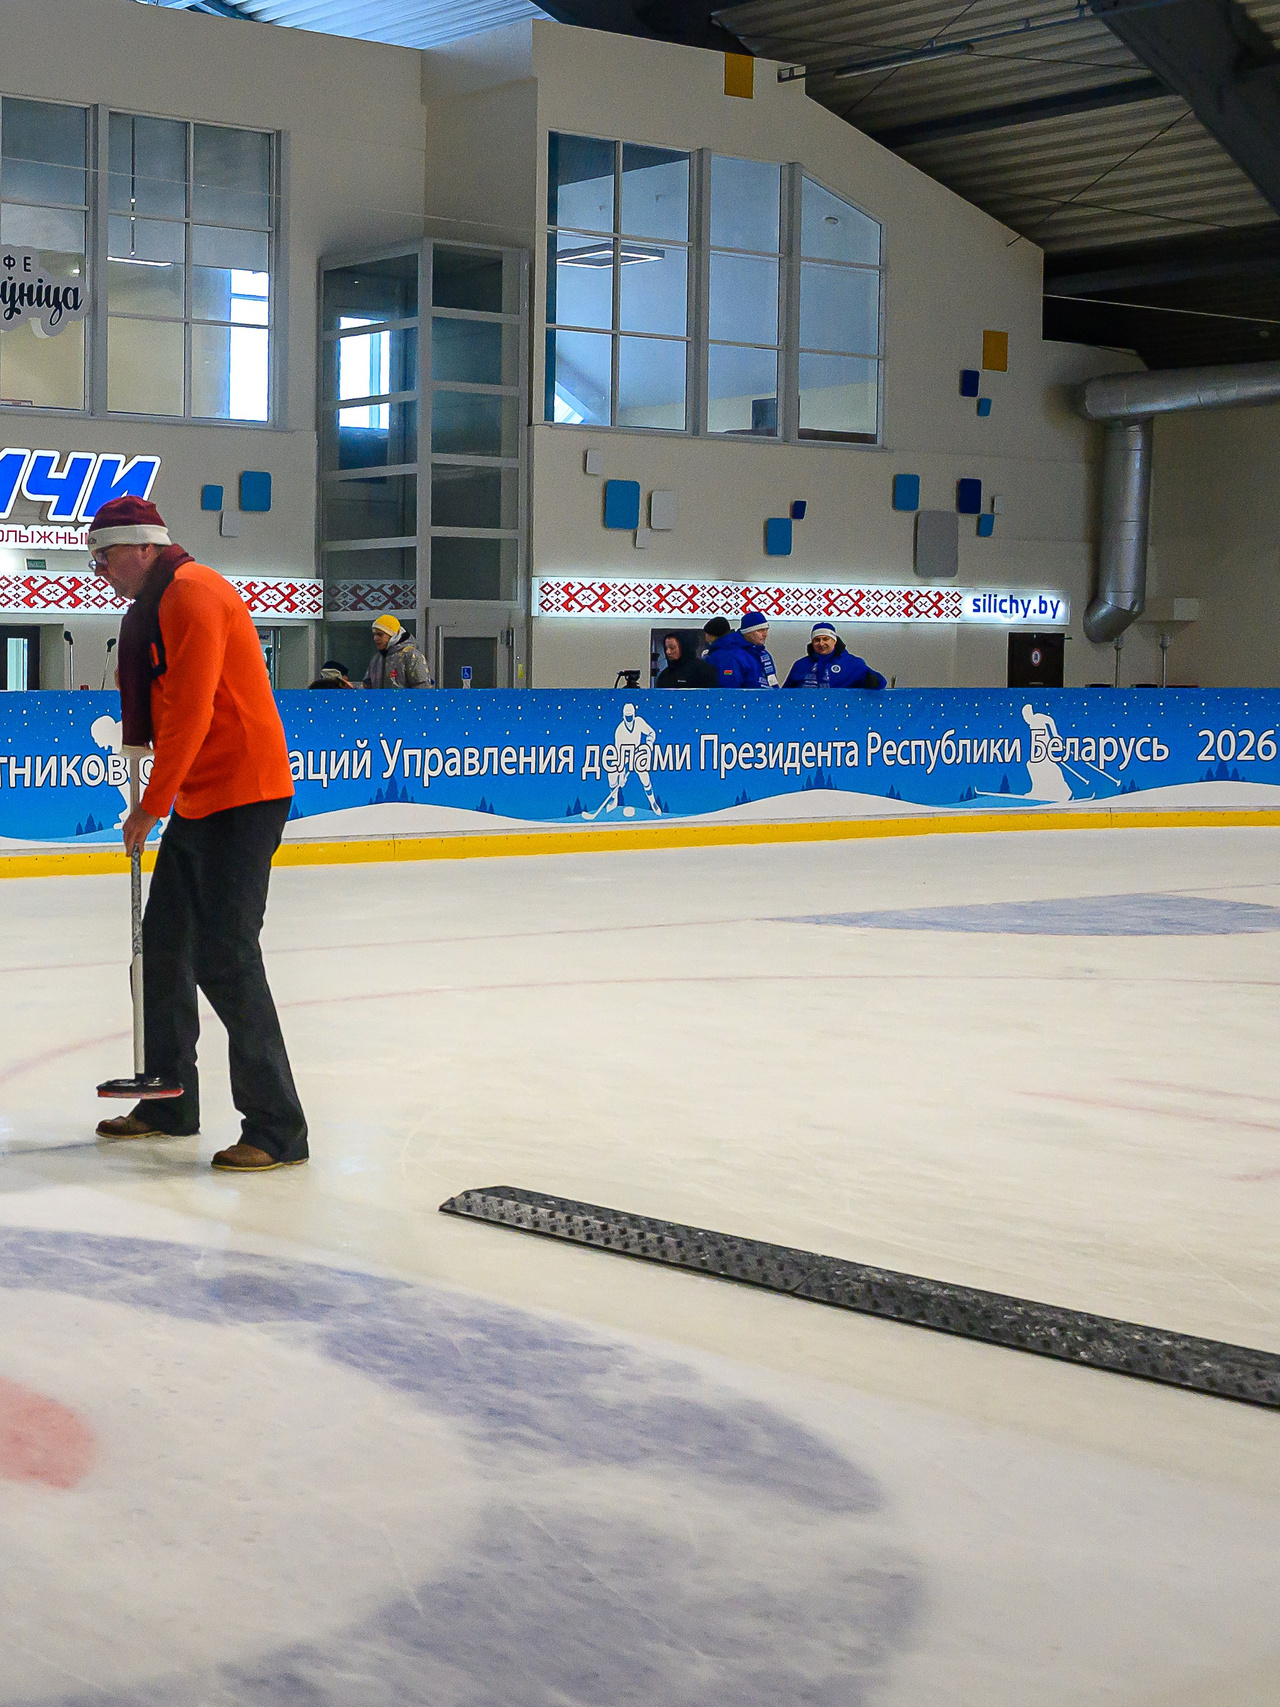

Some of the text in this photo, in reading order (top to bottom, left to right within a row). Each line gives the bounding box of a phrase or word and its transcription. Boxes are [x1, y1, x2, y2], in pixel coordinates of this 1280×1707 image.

[972, 593, 1061, 619] silichy.by
[380, 739, 574, 787] Управления
[581, 742, 691, 780] делами
[699, 734, 859, 779] Президента
[868, 729, 1021, 774] Республики
[1030, 729, 1169, 770] Беларусь
[1197, 729, 1278, 762] 2026
